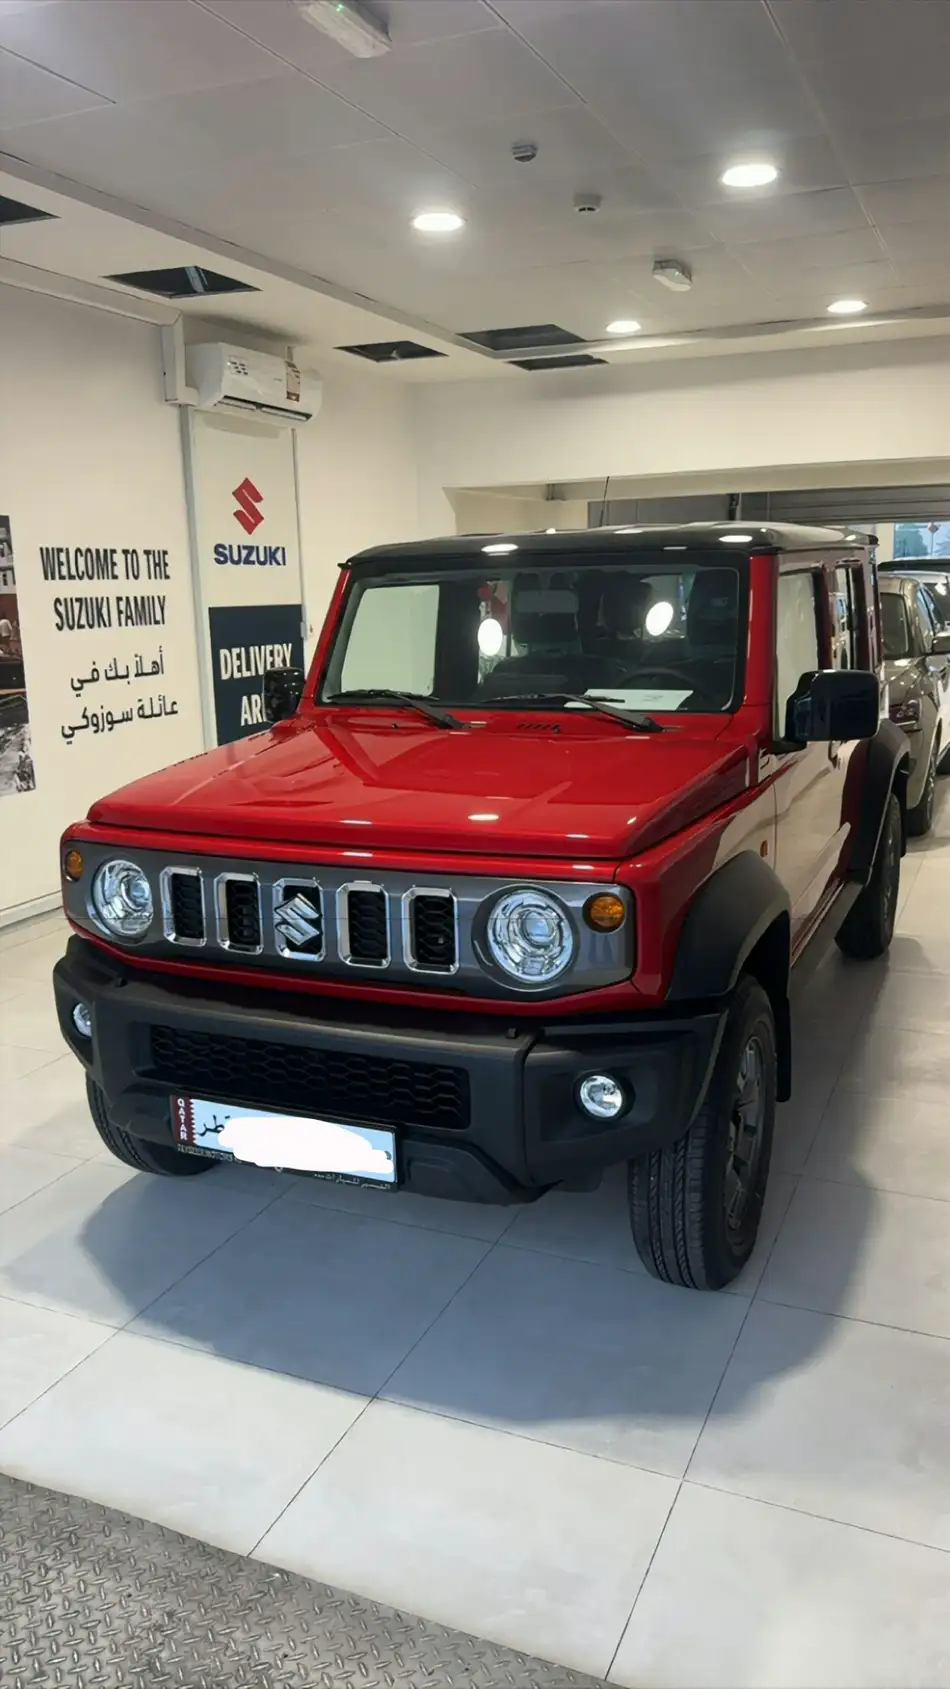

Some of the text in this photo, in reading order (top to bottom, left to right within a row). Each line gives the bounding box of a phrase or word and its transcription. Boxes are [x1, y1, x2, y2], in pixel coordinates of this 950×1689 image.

[39, 546, 170, 580] WELCOME TO THE
[213, 543, 287, 566] SUZUKI
[53, 595, 166, 632] SUZUKI FAMILY
[70, 661, 100, 698] في
[104, 657, 131, 685] بك
[219, 643, 292, 681] DELIVERY
[61, 694, 179, 745] عائلة سوزوكي
[240, 693, 268, 727] AR
[177, 1098, 188, 1141] QATAR
[196, 1114, 231, 1137] طر
